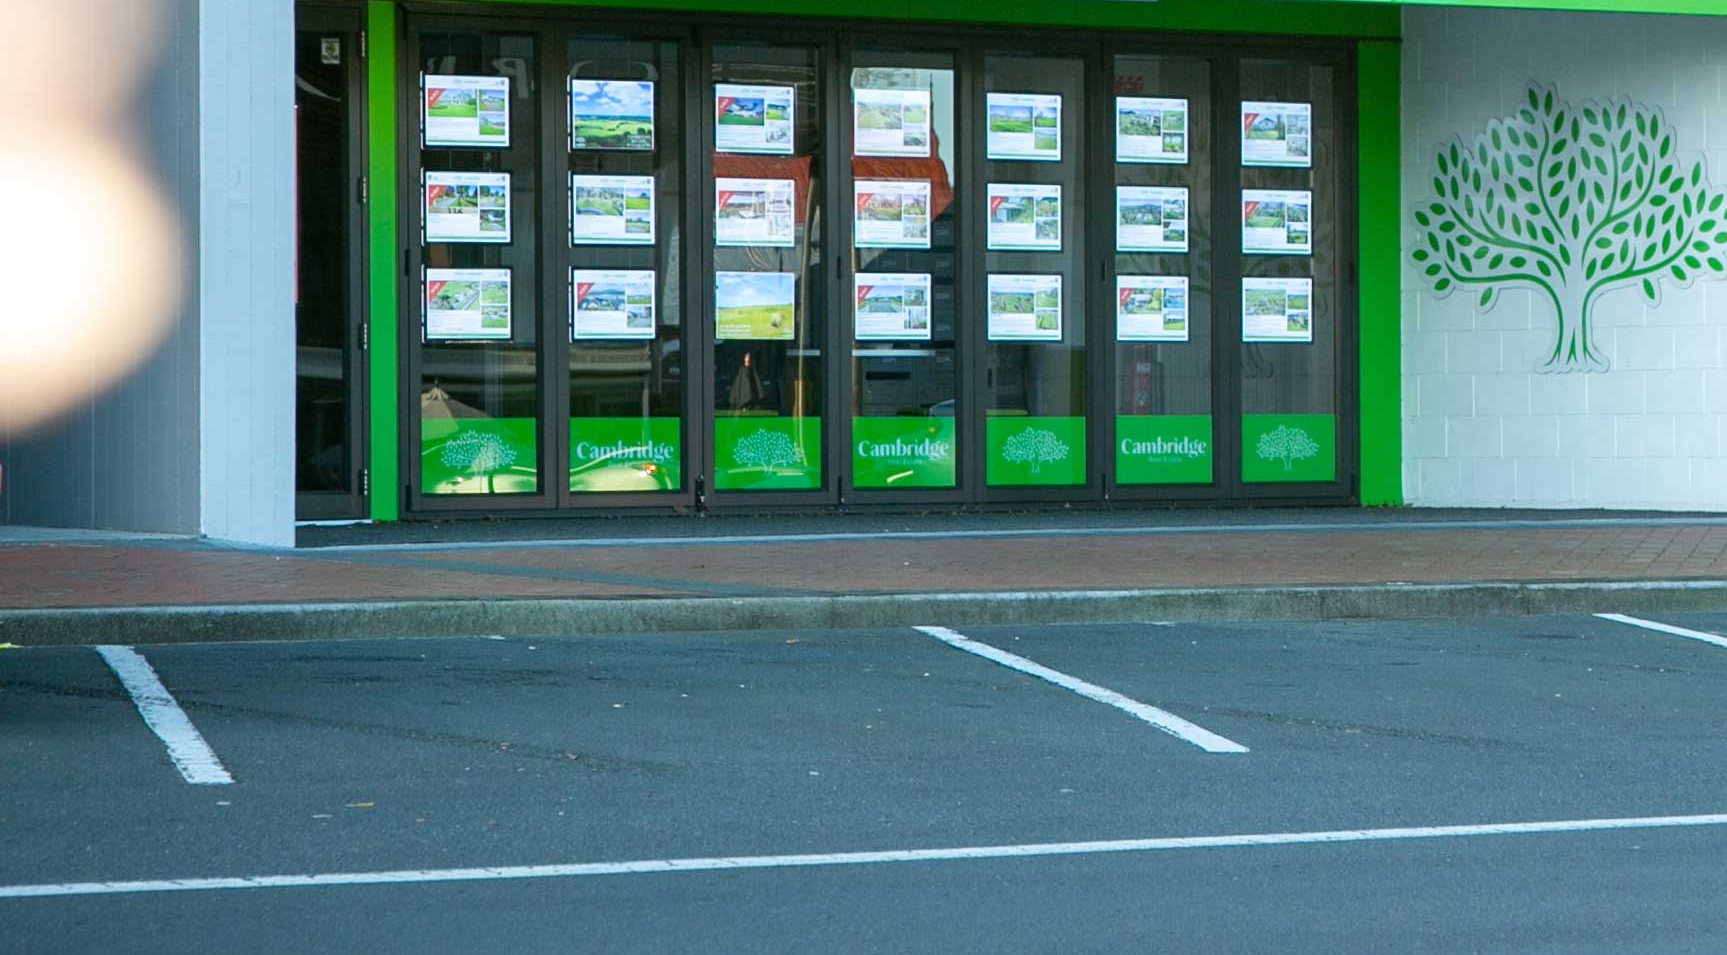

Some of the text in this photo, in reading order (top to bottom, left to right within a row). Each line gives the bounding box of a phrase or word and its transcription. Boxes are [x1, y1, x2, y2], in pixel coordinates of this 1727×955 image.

[576, 439, 675, 464] Cambridge
[857, 437, 950, 461] Cambridge
[1120, 435, 1207, 459] Cambridge
